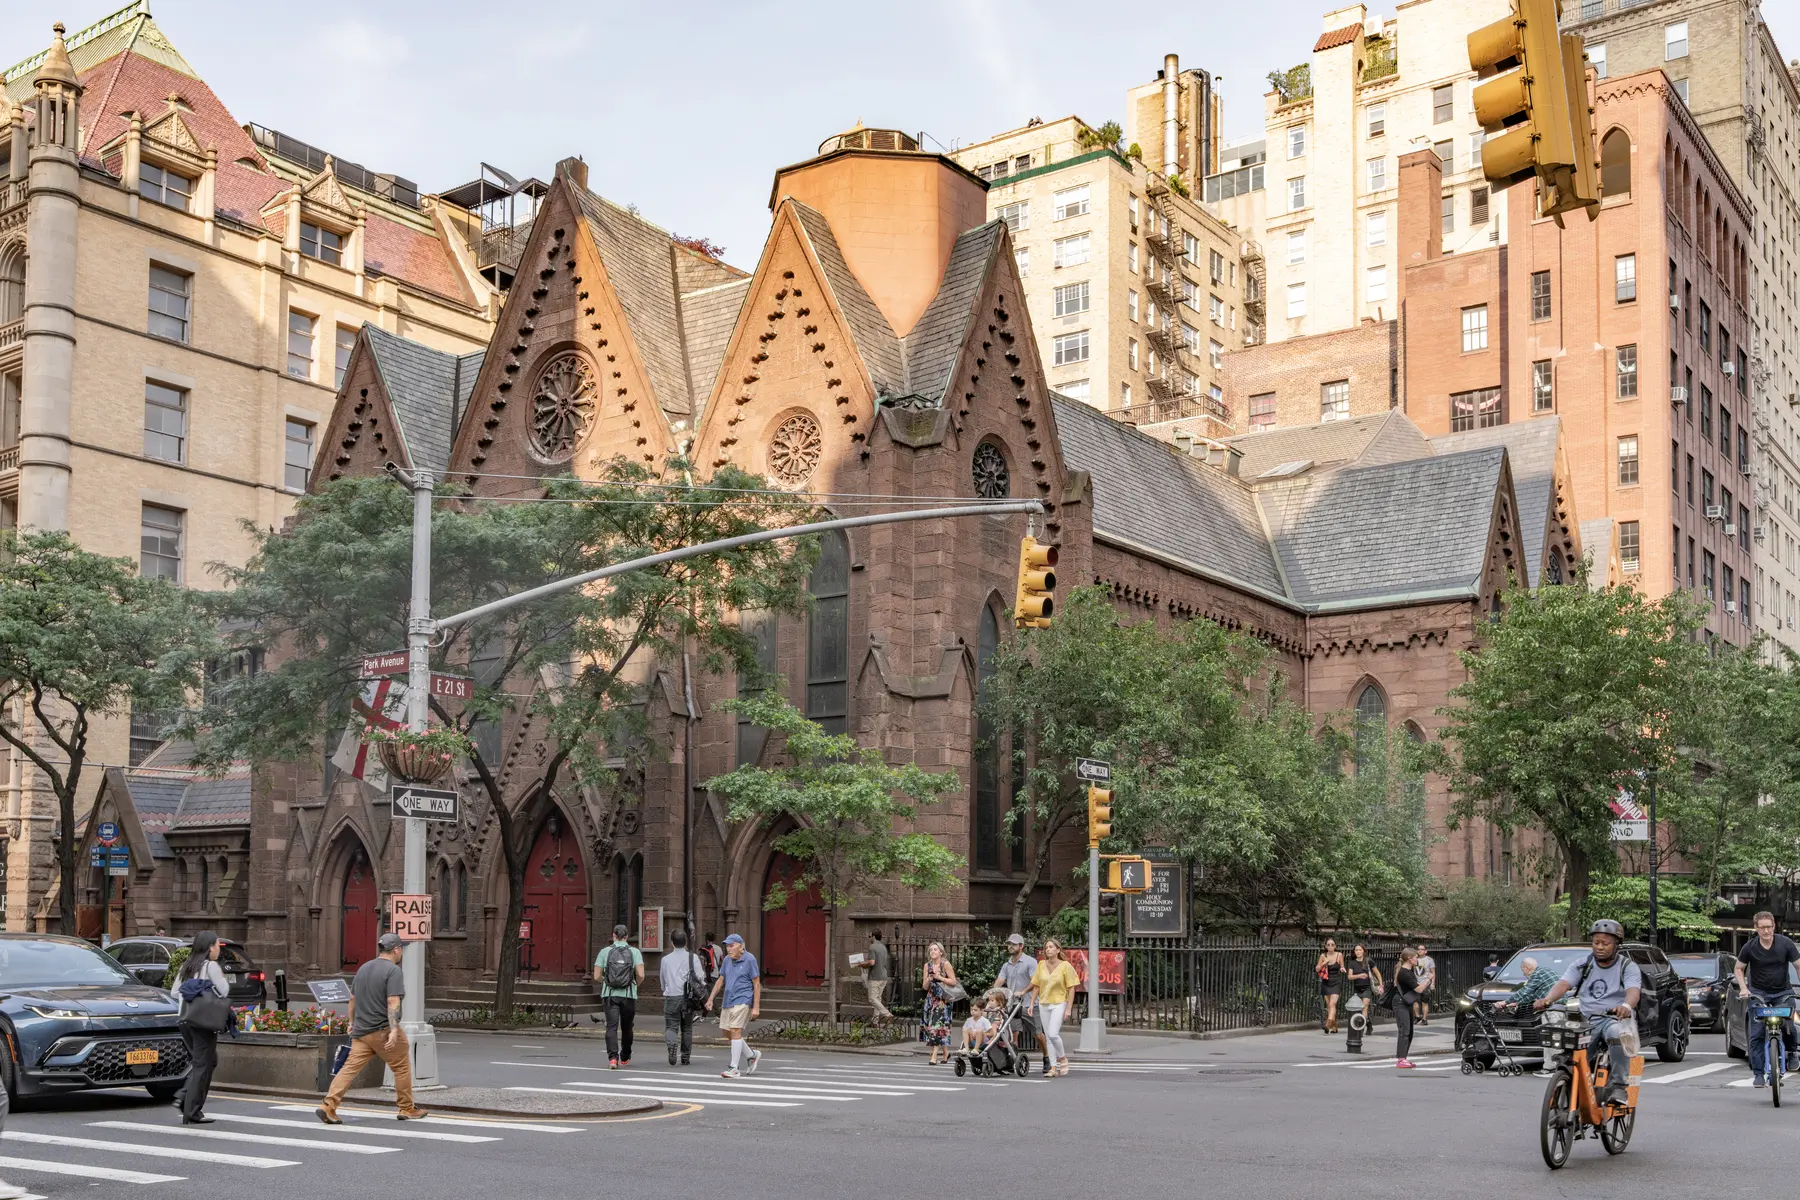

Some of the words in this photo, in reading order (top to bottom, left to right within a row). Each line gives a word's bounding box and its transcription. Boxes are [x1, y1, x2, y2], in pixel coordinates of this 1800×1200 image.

[364, 659, 379, 670] Park
[381, 656, 405, 668] Avenue
[436, 679, 442, 693] E
[444, 680, 453, 695] 21
[456, 681, 465, 696] St
[1081, 764, 1092, 774] ONE
[1096, 767, 1107, 777] WAY
[402, 796, 422, 809] ONE
[430, 799, 450, 812] WAY
